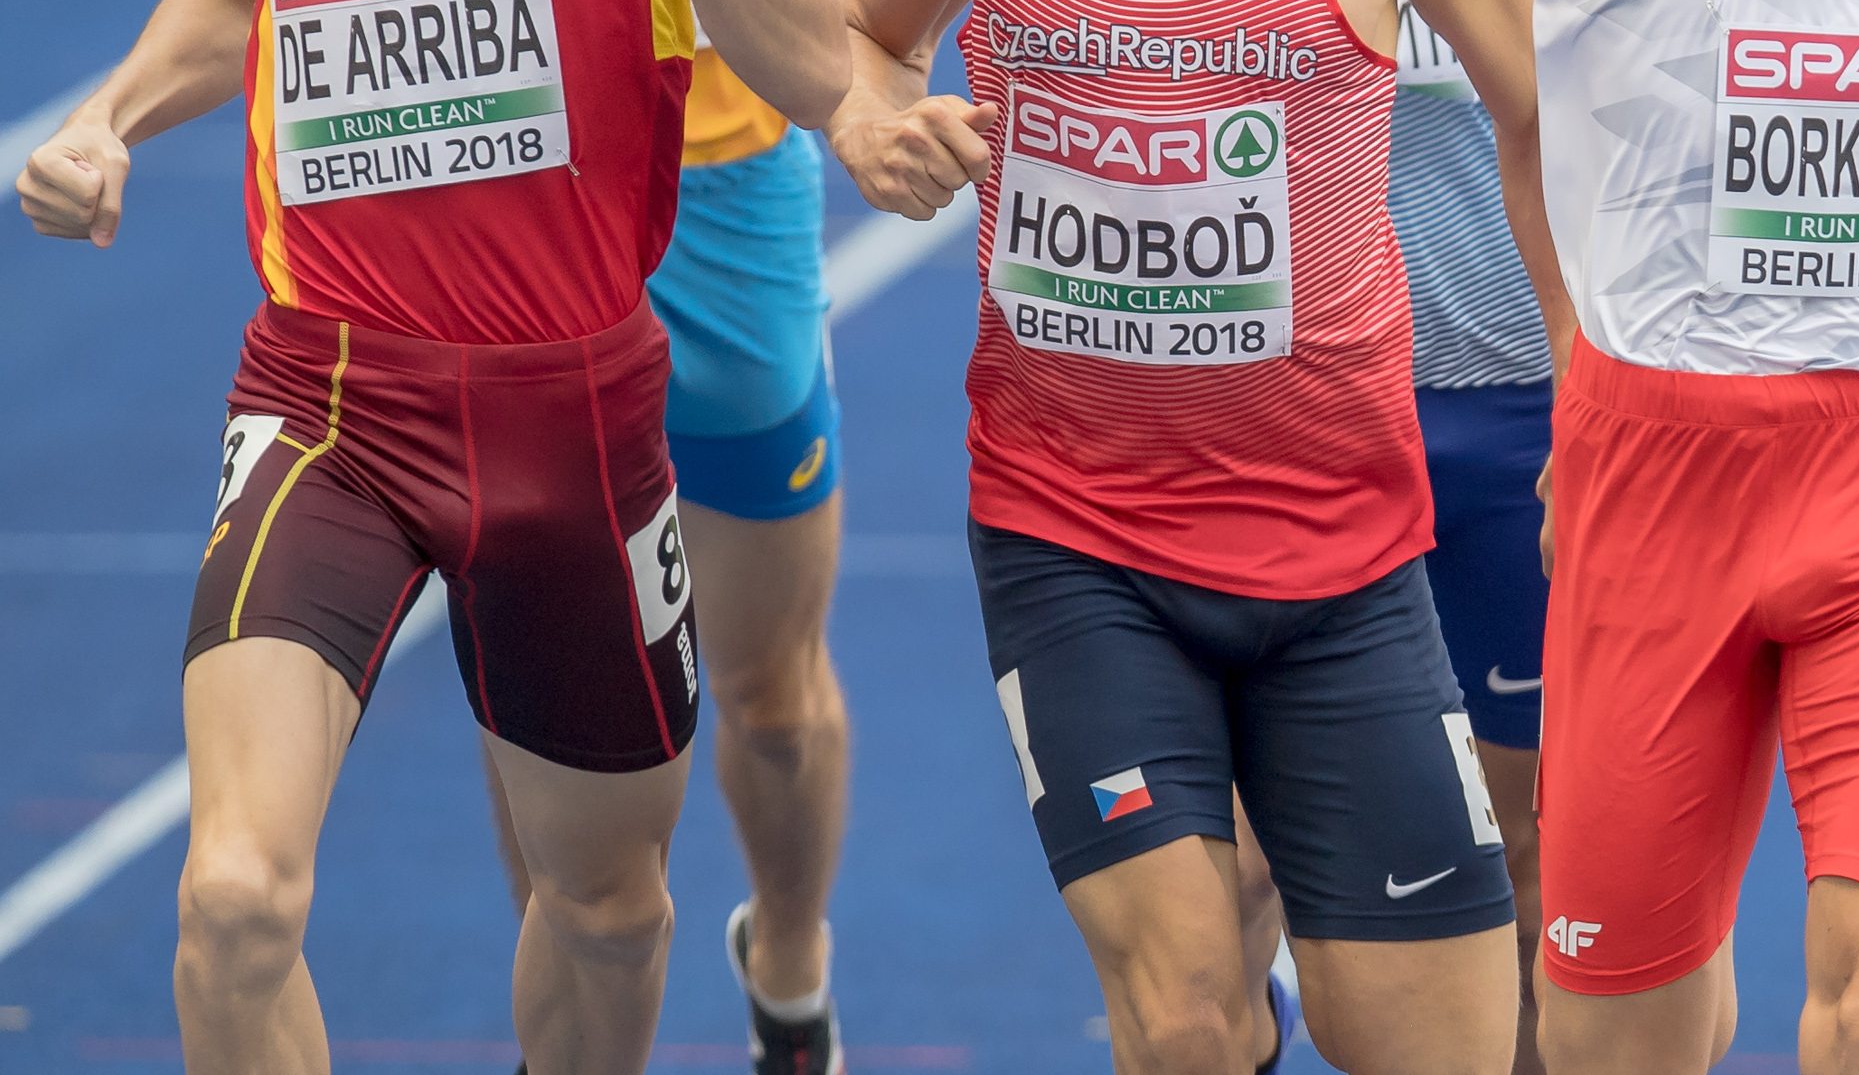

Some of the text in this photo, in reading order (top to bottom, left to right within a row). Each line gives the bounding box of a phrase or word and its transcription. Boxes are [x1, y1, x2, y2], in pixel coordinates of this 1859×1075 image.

[279, 18, 331, 105] DE
[986, 11, 1319, 82] CzechRepublic
[328, 120, 337, 140] I
[343, 110, 394, 138] RUN
[1017, 100, 1202, 177] SPAR
[301, 127, 544, 195] BERLIN 2018
[1008, 190, 1275, 279] HODBOĎ
[1785, 215, 1791, 236] I
[1800, 217, 1856, 239] RUN
[1055, 279, 1060, 297] I
[1067, 281, 1118, 308] RUN
[1016, 303, 1266, 356] BERLIN 2018
[657, 514, 685, 606] 8
[1547, 915, 1602, 957] 4F
